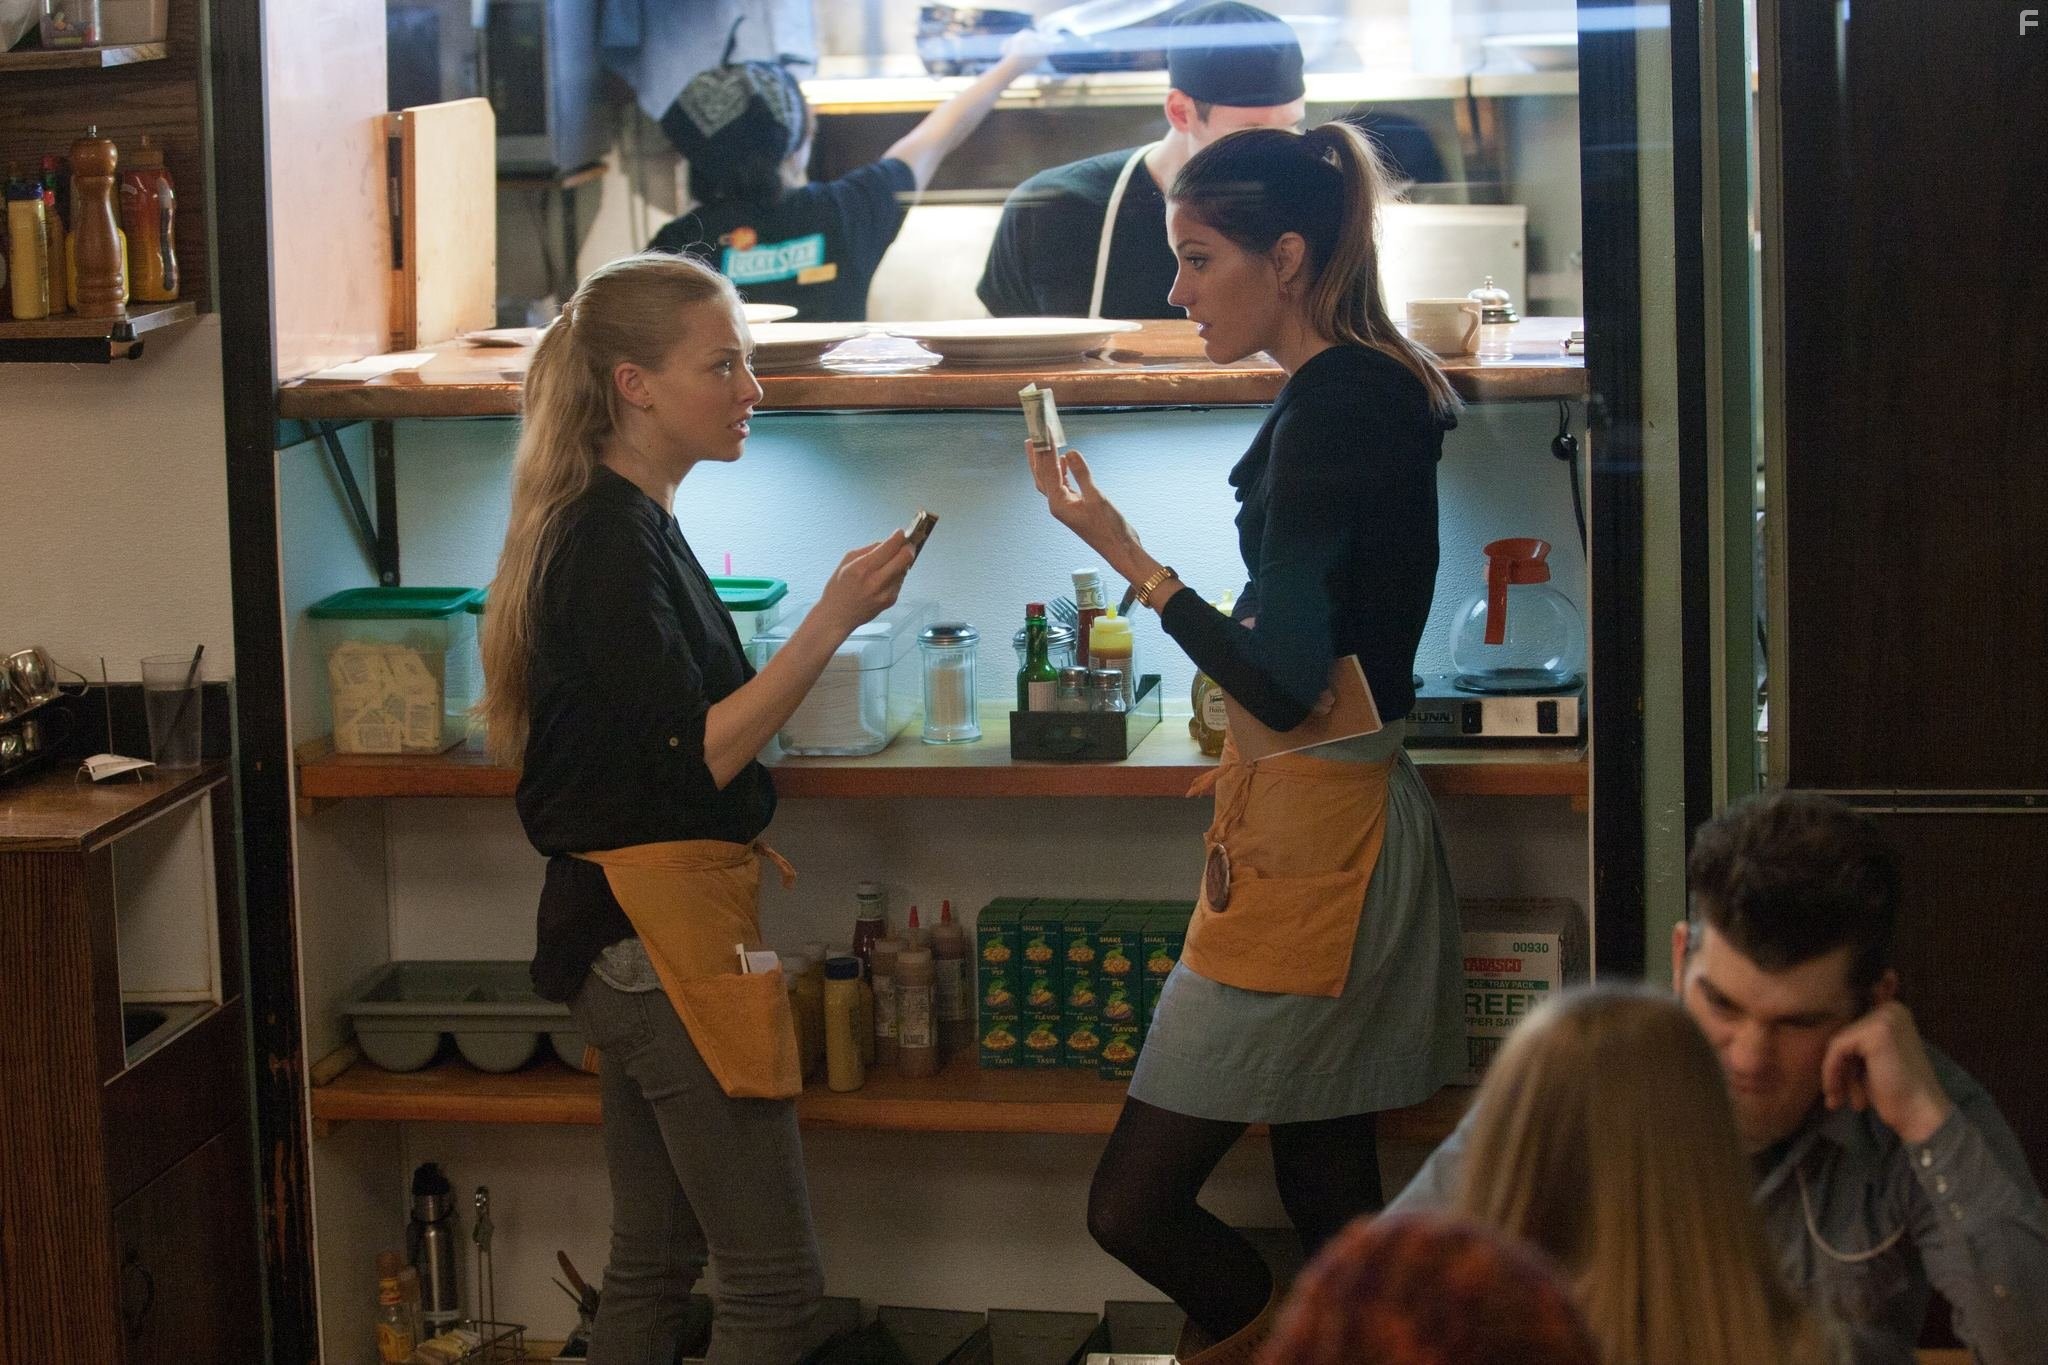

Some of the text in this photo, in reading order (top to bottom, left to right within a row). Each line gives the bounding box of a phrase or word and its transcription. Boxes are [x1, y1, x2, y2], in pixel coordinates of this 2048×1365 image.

[1406, 711, 1450, 721] BUNN
[1099, 936, 1121, 944] SHAKE
[1143, 936, 1166, 944] SHAKE
[1512, 942, 1549, 953] 00930
[1465, 993, 1540, 1015] REE
[1111, 1025, 1138, 1033] FLAVOR
